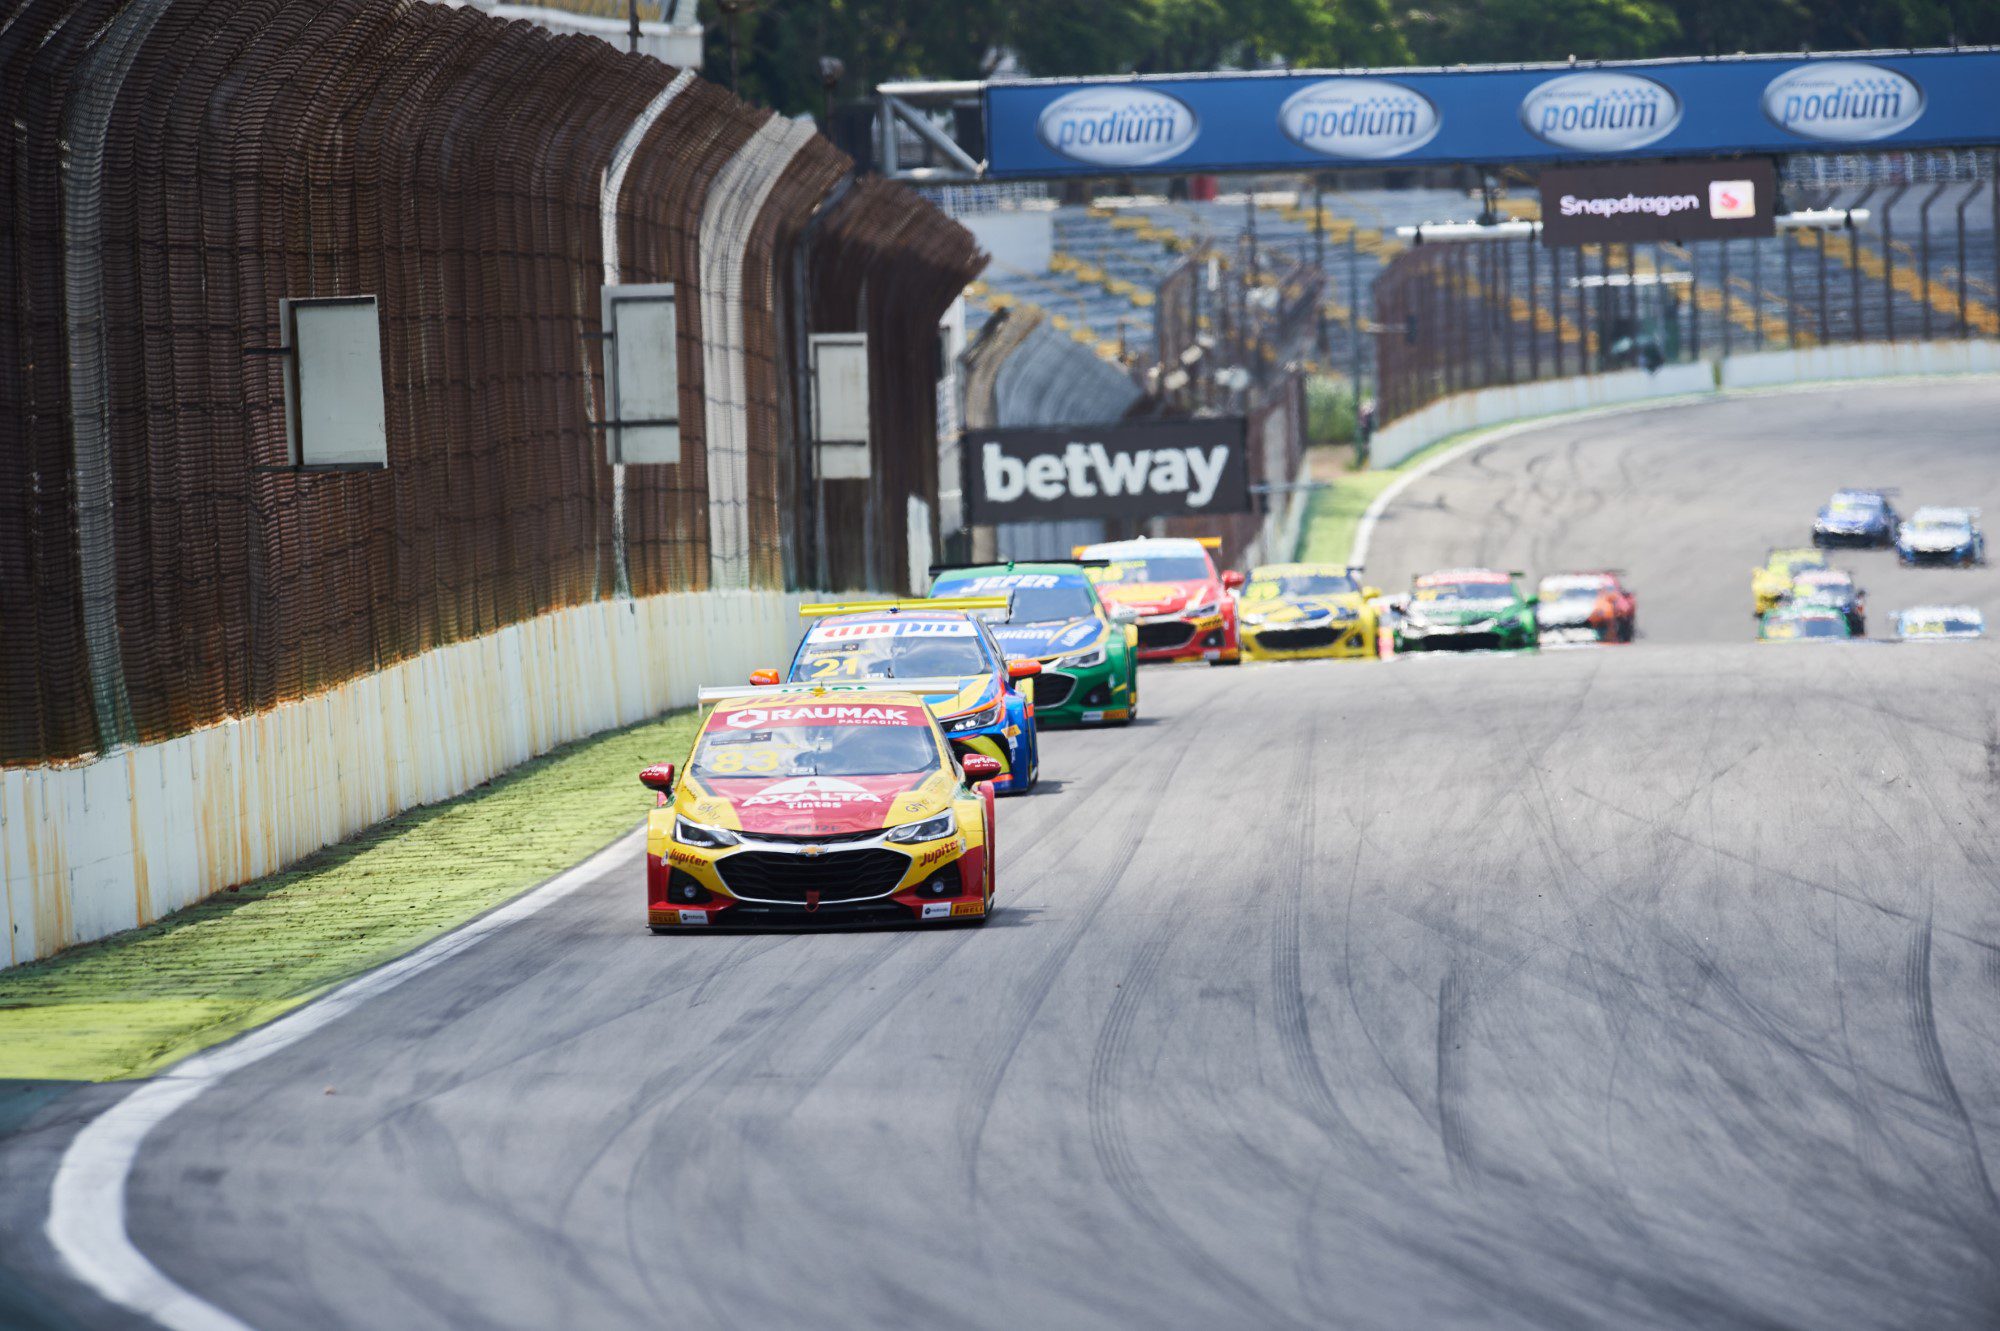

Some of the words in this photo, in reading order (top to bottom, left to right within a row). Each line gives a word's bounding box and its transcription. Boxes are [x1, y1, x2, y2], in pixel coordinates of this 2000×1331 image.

[1540, 98, 1657, 134] podium
[1782, 86, 1900, 124] podium
[1058, 109, 1176, 149] podium
[1298, 103, 1416, 141] podium
[1559, 191, 1700, 219] Snapdragon
[982, 441, 1230, 508] betway
[960, 574, 1060, 594] JEFER
[811, 657, 859, 679] 21
[771, 706, 909, 722] RAUMAK
[838, 718, 909, 726] PACKAGING
[711, 751, 780, 773] 83
[741, 789, 883, 808] AXALTA
[786, 800, 842, 809] Tintas
[669, 848, 708, 867] Jupiter
[919, 839, 959, 867] Jupiter
